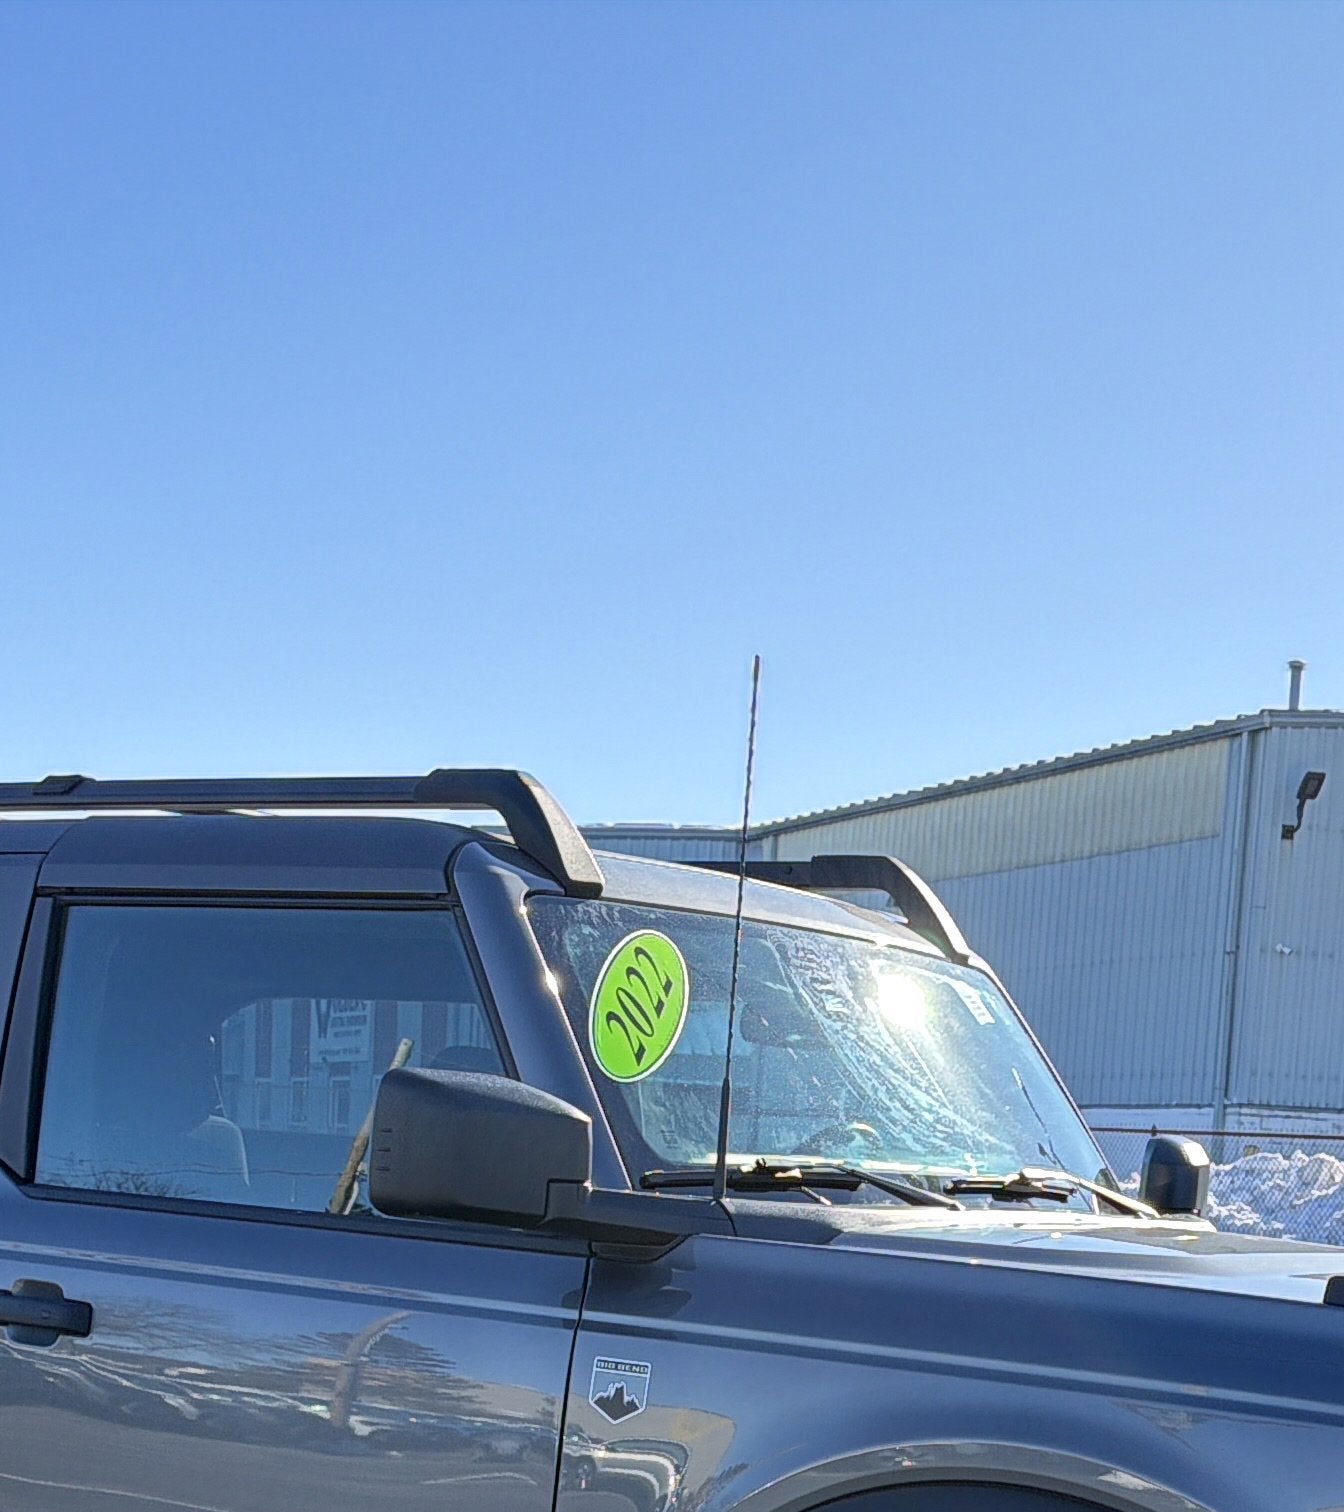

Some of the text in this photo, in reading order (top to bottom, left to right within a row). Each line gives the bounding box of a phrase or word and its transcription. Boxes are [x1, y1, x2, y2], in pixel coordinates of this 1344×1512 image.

[606, 946, 673, 1067] 2022
[597, 1360, 648, 1374] BIG BEND
